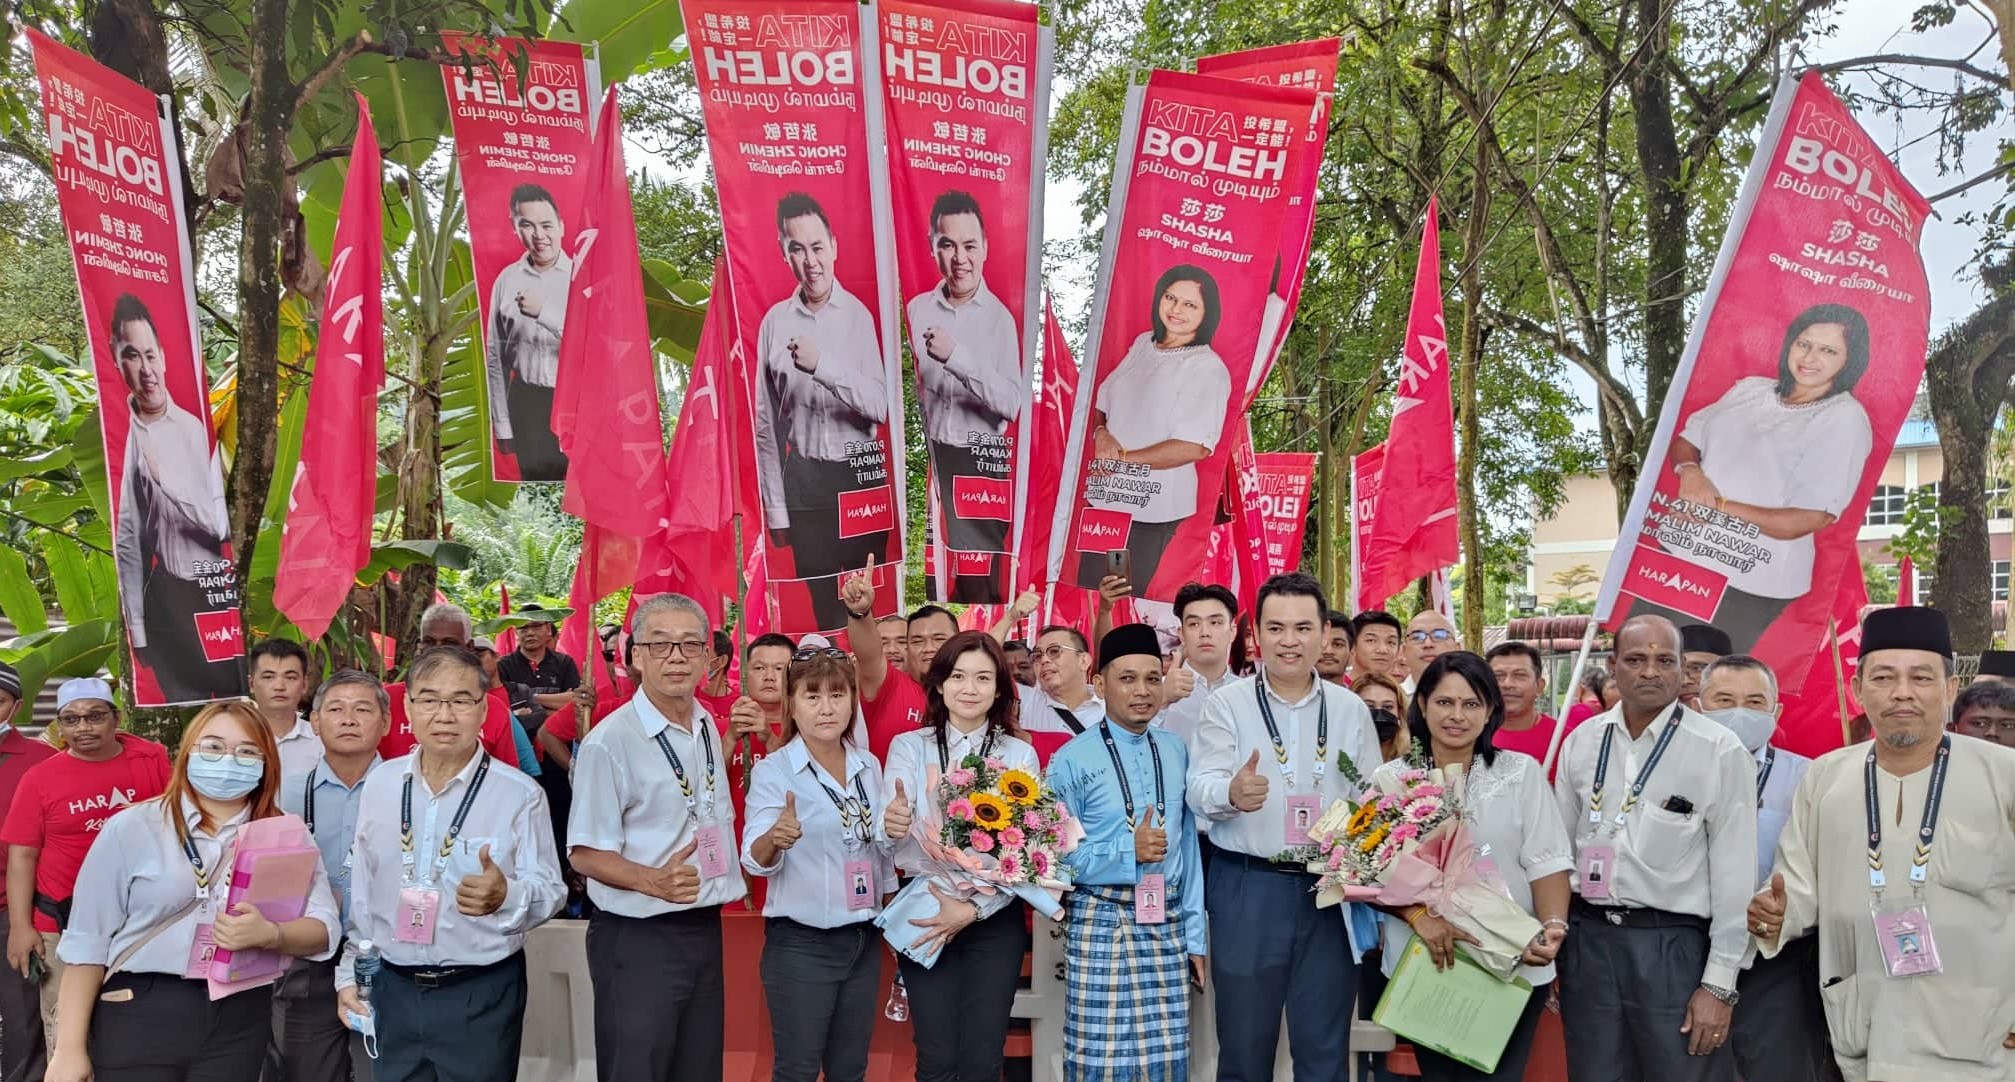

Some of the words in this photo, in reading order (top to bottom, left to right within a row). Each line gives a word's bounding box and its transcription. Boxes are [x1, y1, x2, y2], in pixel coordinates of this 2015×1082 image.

[1148, 99, 1238, 143] KITA
[1142, 126, 1287, 181] BOLEH
[1161, 214, 1233, 243] SHASHA
[1801, 242, 1889, 278] SHASHA
[1111, 476, 1161, 494] NAWAR
[1259, 473, 1287, 495] ITA
[1645, 509, 1703, 537] MALIM
[1704, 528, 1771, 564] NAWAR
[1639, 565, 1711, 598] HARAPAN
[69, 786, 136, 815] HARAP
